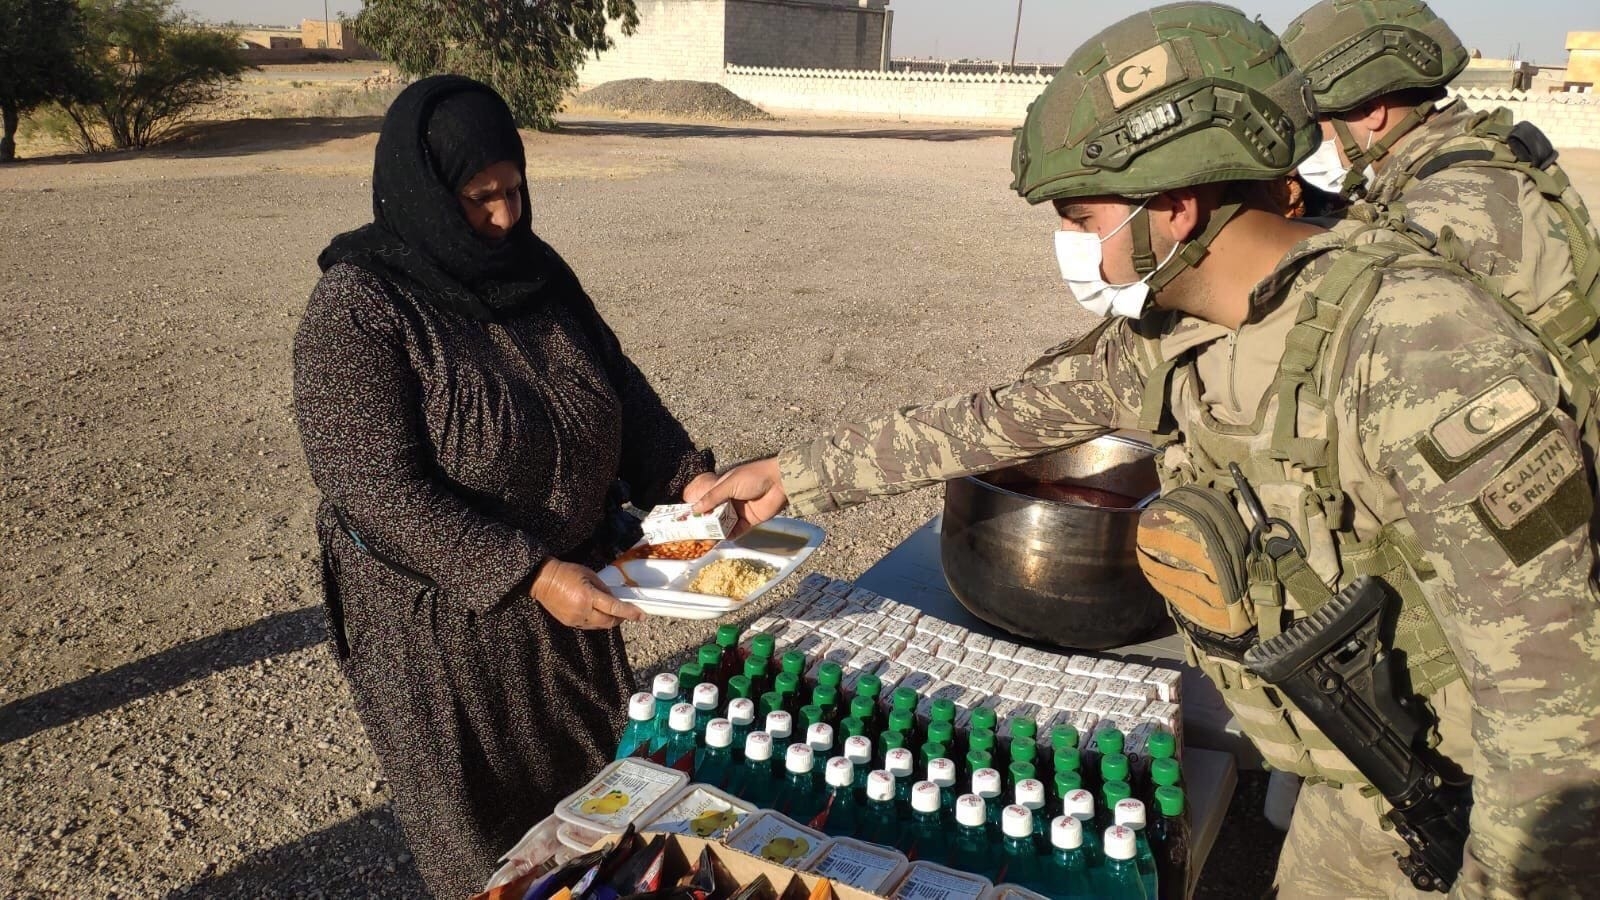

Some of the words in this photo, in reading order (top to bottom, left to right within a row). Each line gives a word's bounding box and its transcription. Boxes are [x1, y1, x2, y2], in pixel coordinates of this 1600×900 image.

[1488, 440, 1563, 506] F.C.ALTIN
[1508, 501, 1521, 515] B
[1524, 484, 1545, 502] Rh
[1547, 464, 1565, 485] (+)
